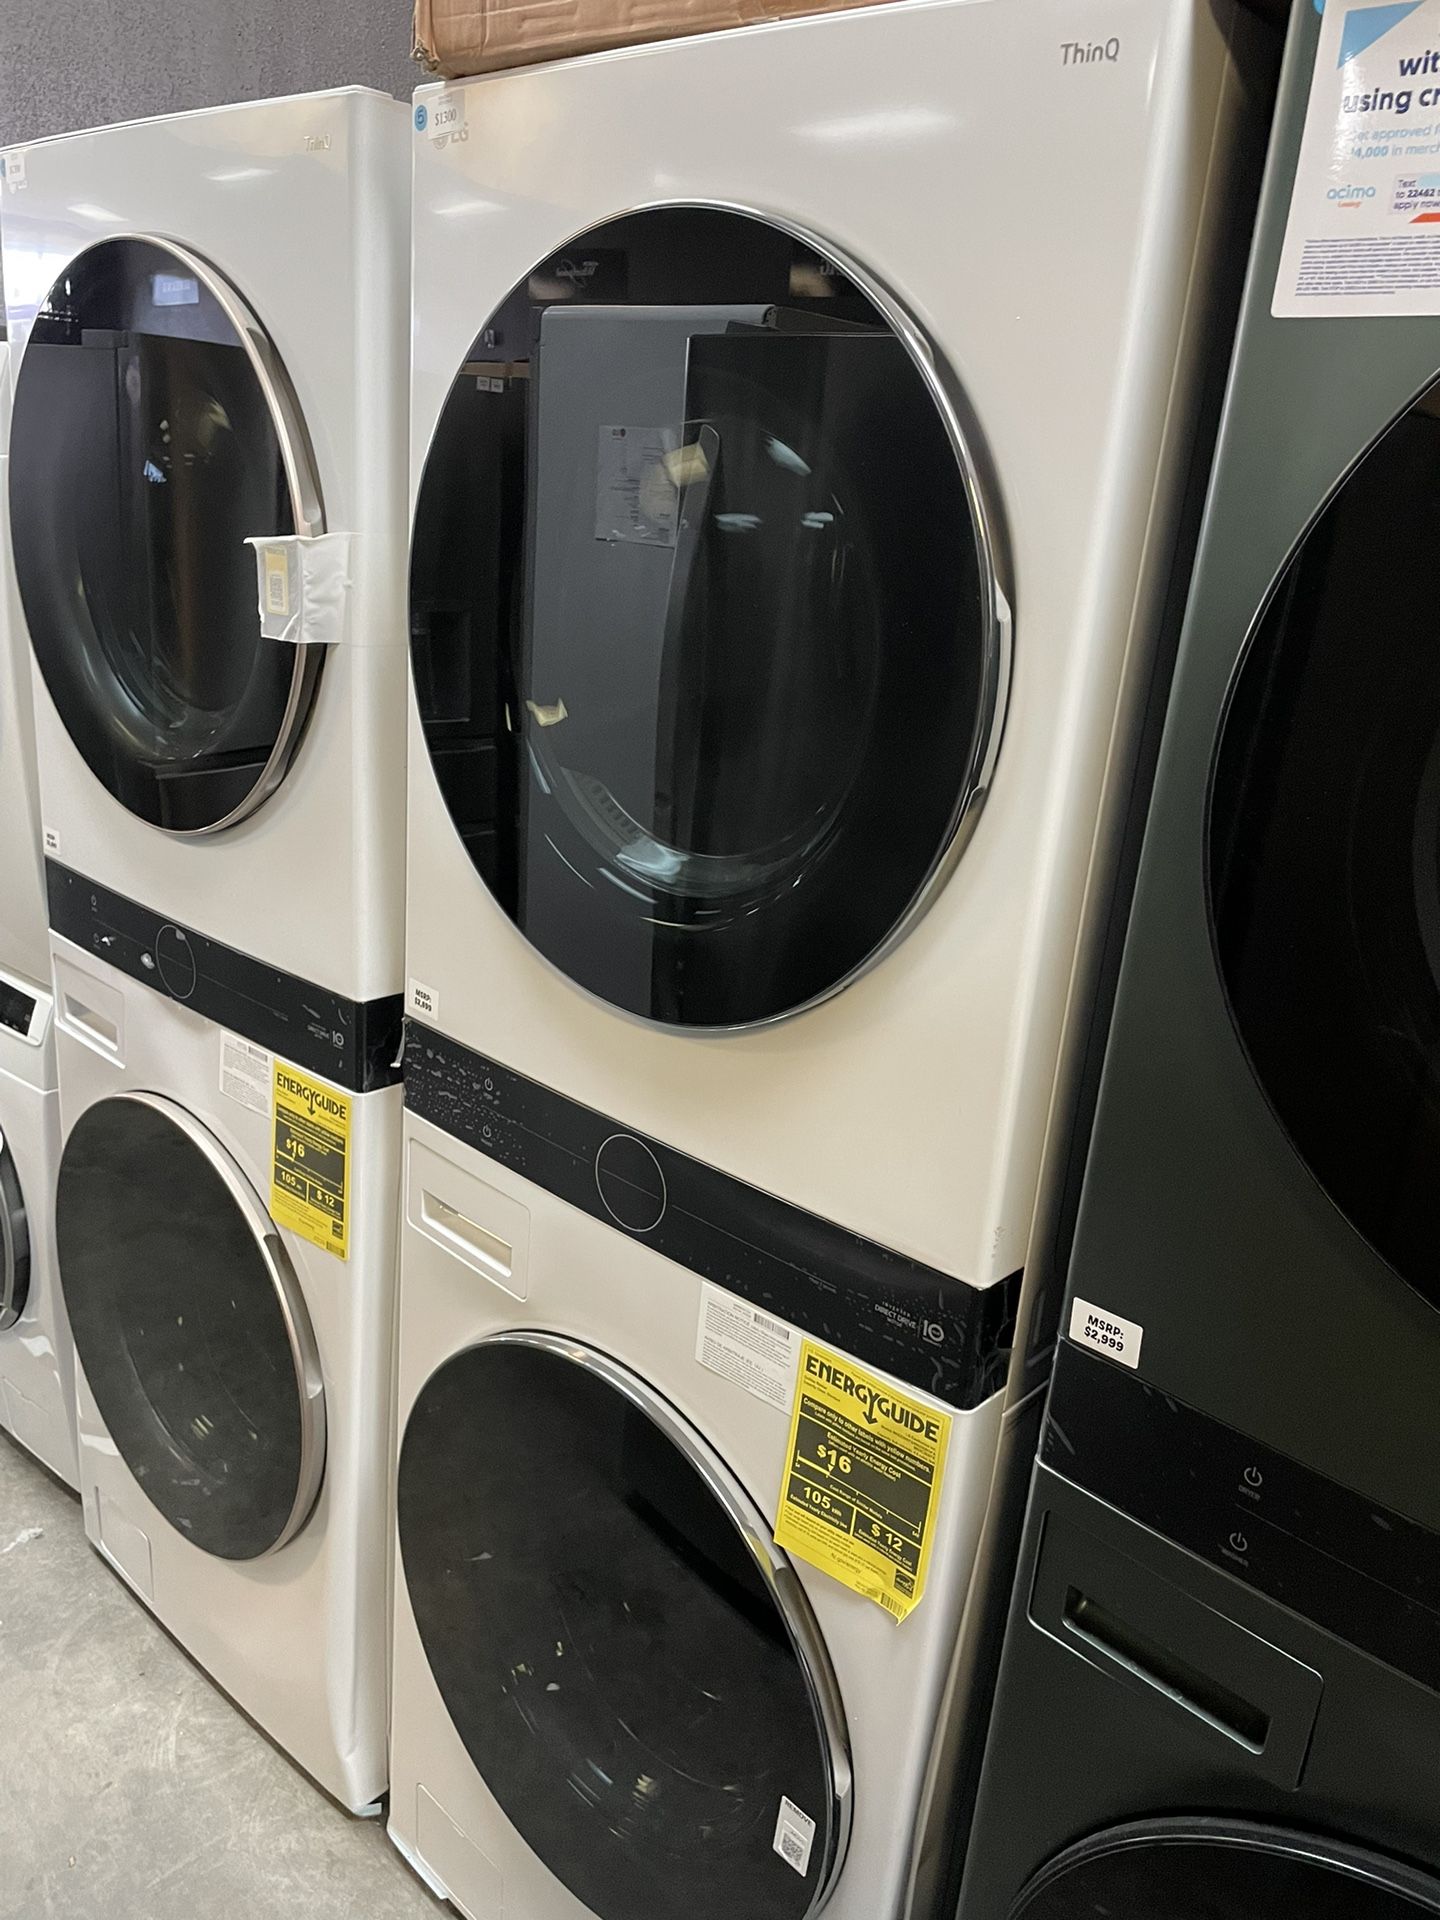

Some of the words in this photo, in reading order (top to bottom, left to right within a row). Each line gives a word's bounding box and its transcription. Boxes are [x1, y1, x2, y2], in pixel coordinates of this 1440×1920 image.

[1061, 38, 1120, 66] ThinQ
[1344, 88, 1412, 114] using
[1372, 123, 1432, 141] approved
[1327, 184, 1376, 200] acima
[1407, 188, 1435, 199] 22462
[277, 1072, 347, 1120] ENERGYGUIDE
[1084, 1326, 1124, 1352] $2,999
[1088, 1315, 1124, 1340] MSRP:
[803, 1397, 827, 1414] Compare
[806, 1354, 940, 1443] ENERGYGUIDE
[817, 1444, 851, 1474] $16
[804, 1486, 831, 1509] 105
[885, 1533, 903, 1552] 12
